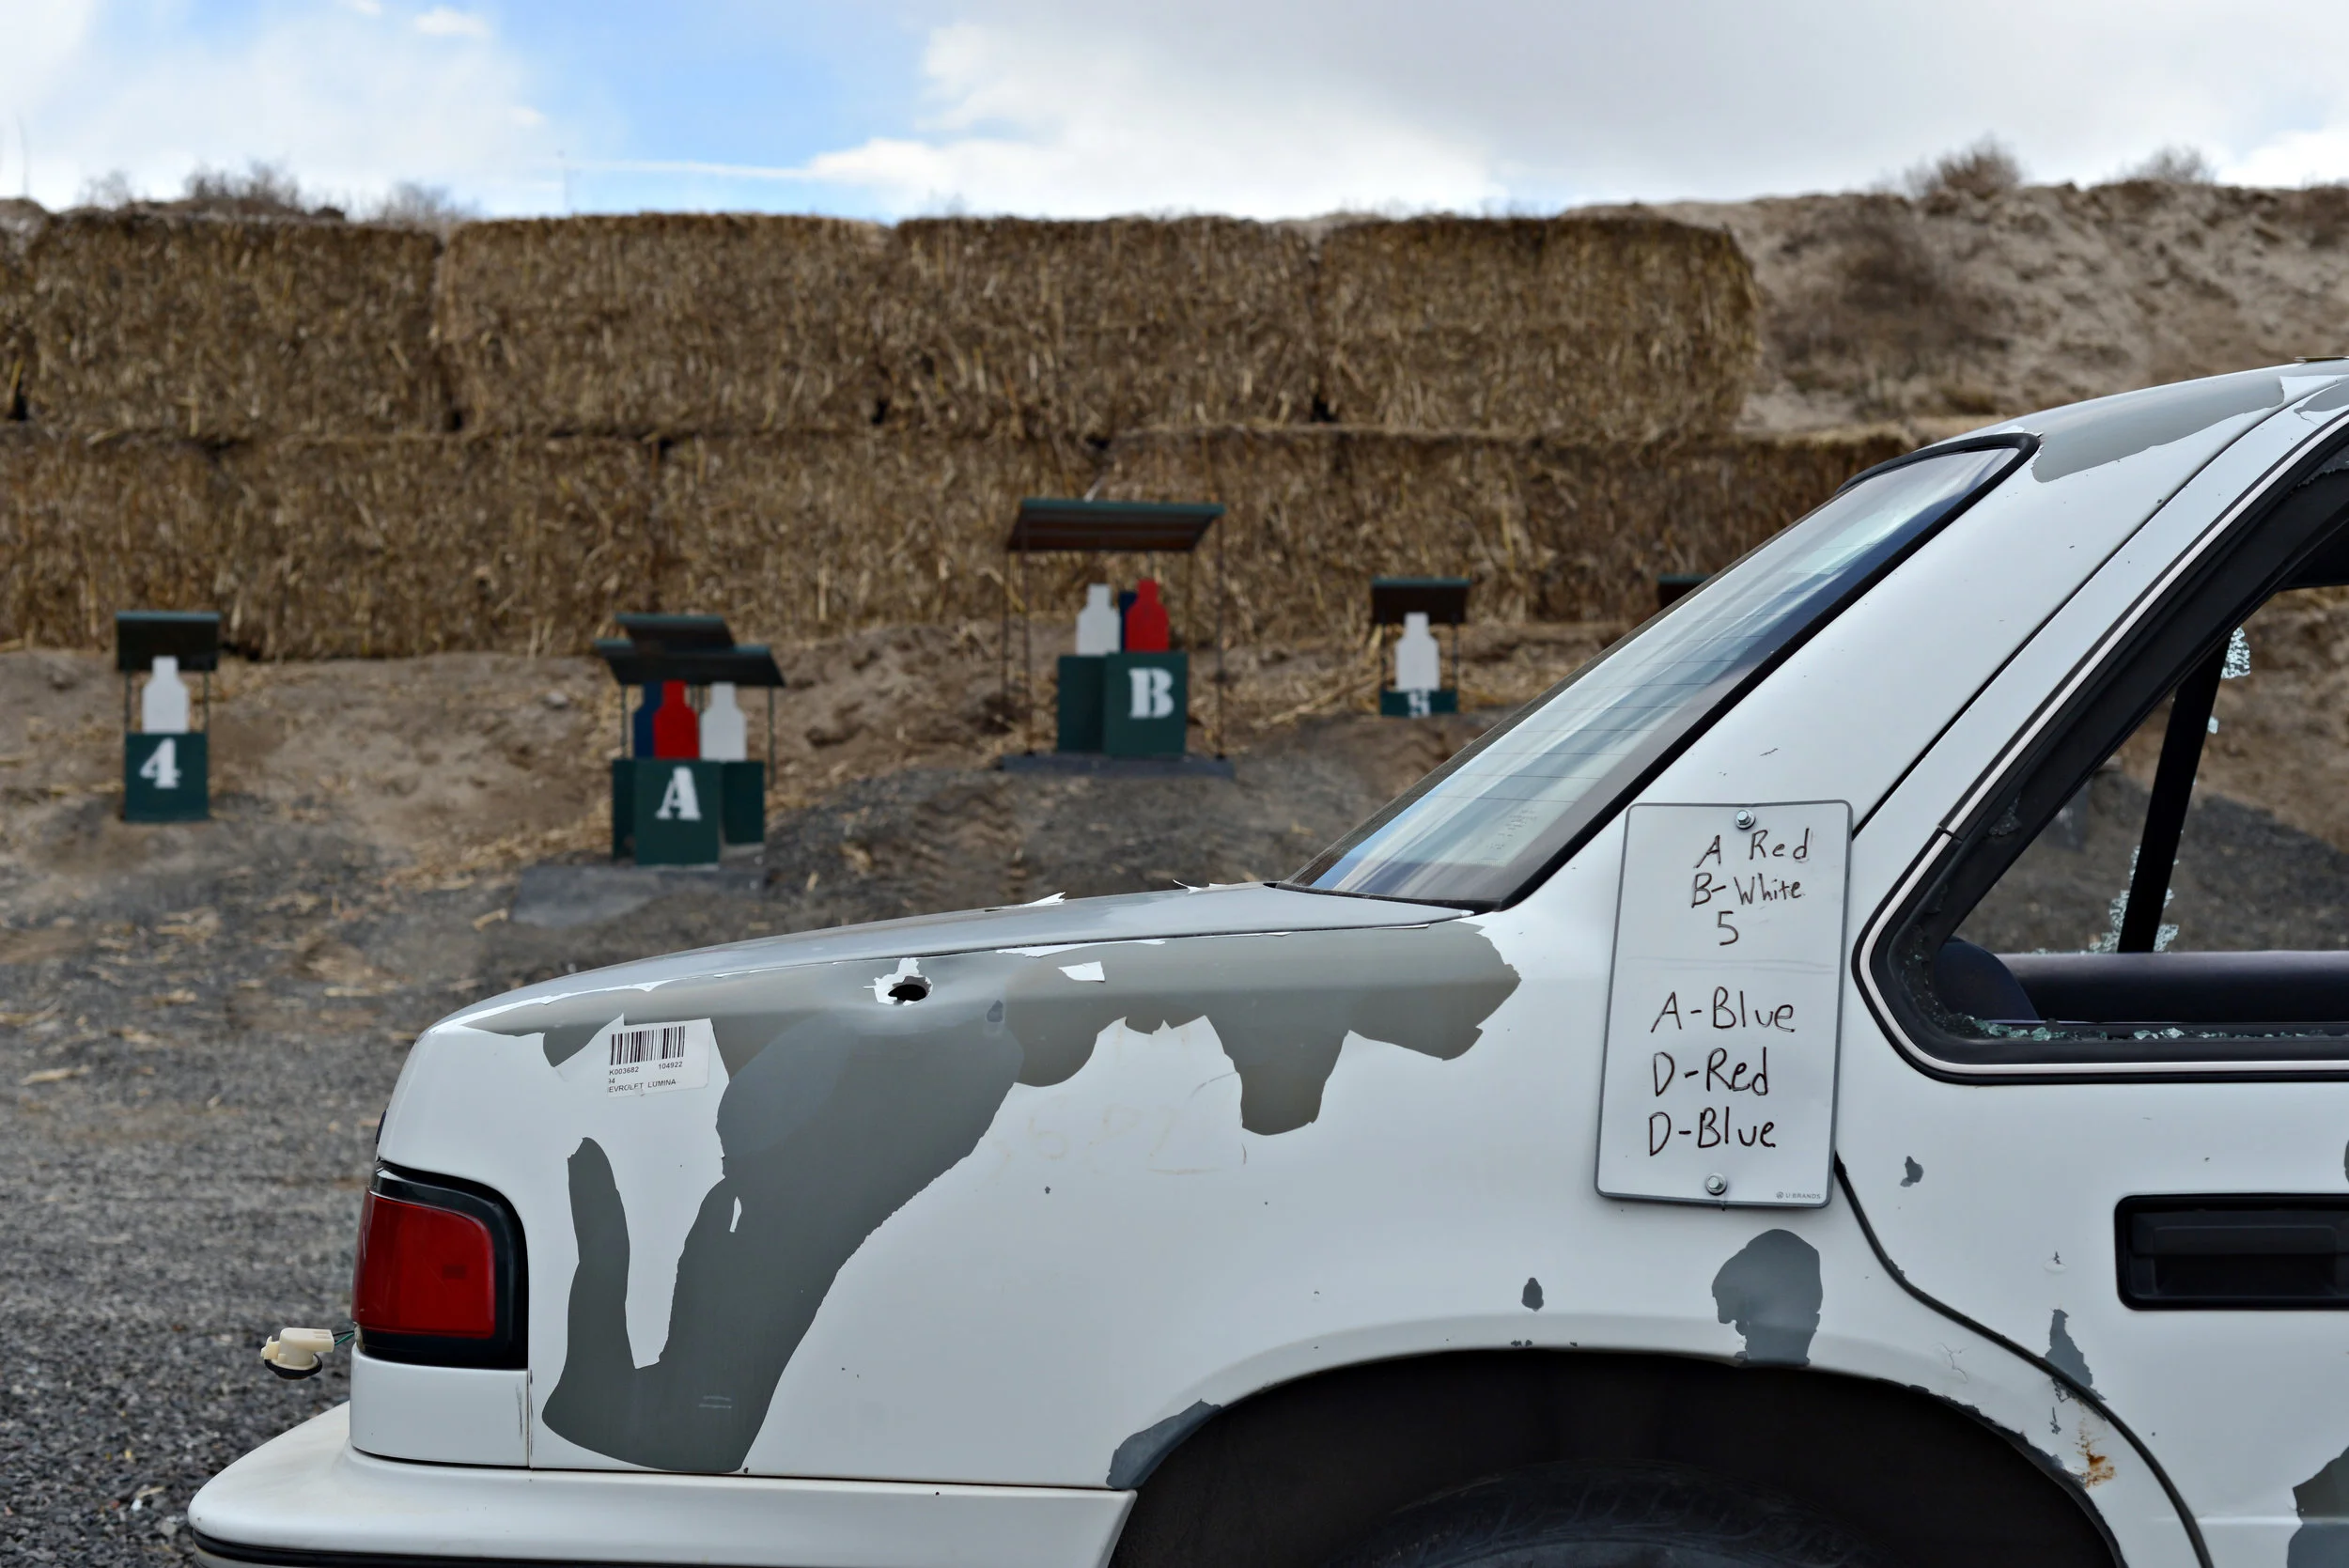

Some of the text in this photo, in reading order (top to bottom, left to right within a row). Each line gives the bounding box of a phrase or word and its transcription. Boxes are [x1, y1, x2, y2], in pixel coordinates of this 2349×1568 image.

[1128, 667, 1175, 721] B
[138, 737, 183, 789] 4
[655, 765, 703, 822] A
[1692, 827, 1811, 869] A Red
[1717, 910, 1740, 946] 5
[647, 1079, 677, 1089] LUMINA
[658, 1061, 683, 1070] 104922
[1648, 1106, 1777, 1157] D-Blue
